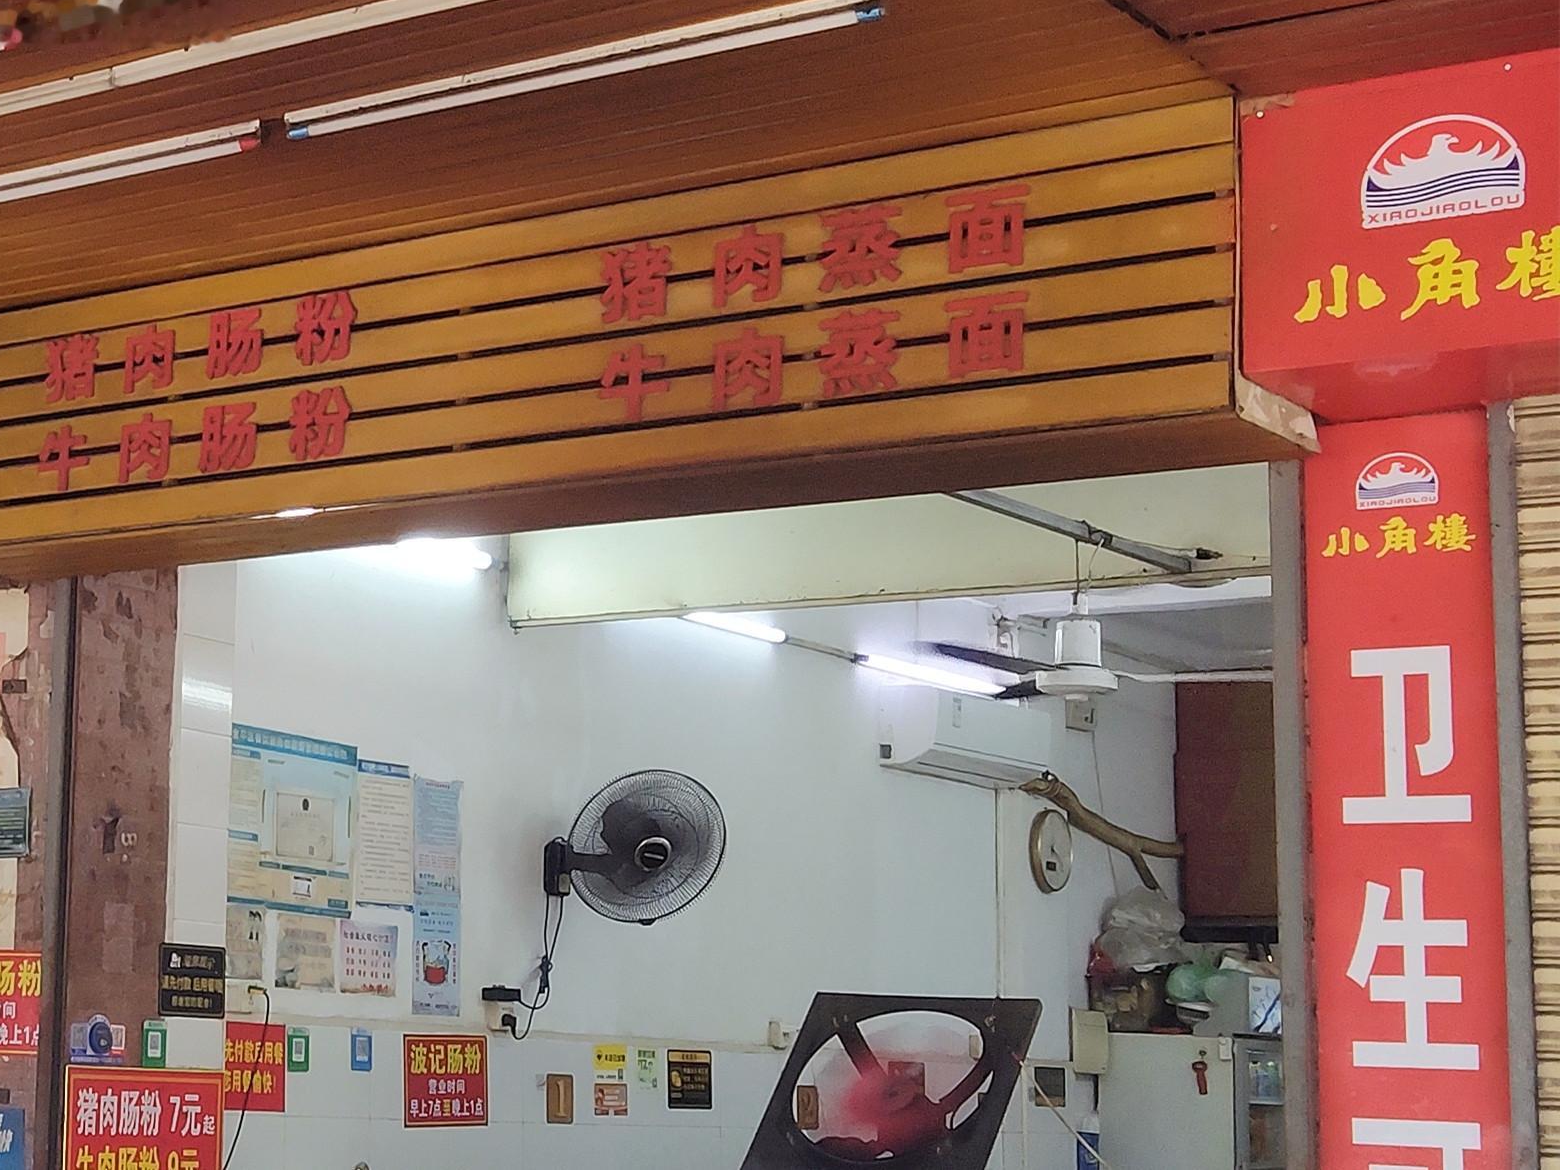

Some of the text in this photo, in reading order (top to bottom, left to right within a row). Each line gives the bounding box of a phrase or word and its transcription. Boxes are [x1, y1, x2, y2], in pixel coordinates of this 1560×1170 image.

[598, 183, 1032, 325] 猪肉蒸面
[44, 290, 359, 405] 猪肉肠粉
[598, 290, 1032, 422] 牛肉蒸面
[38, 385, 355, 493] 牛肉肠粉
[1342, 644, 1483, 1170] 卫生
[76, 1087, 162, 1137] 猪肉肠粉
[409, 1042, 482, 1076] 波记肠粉
